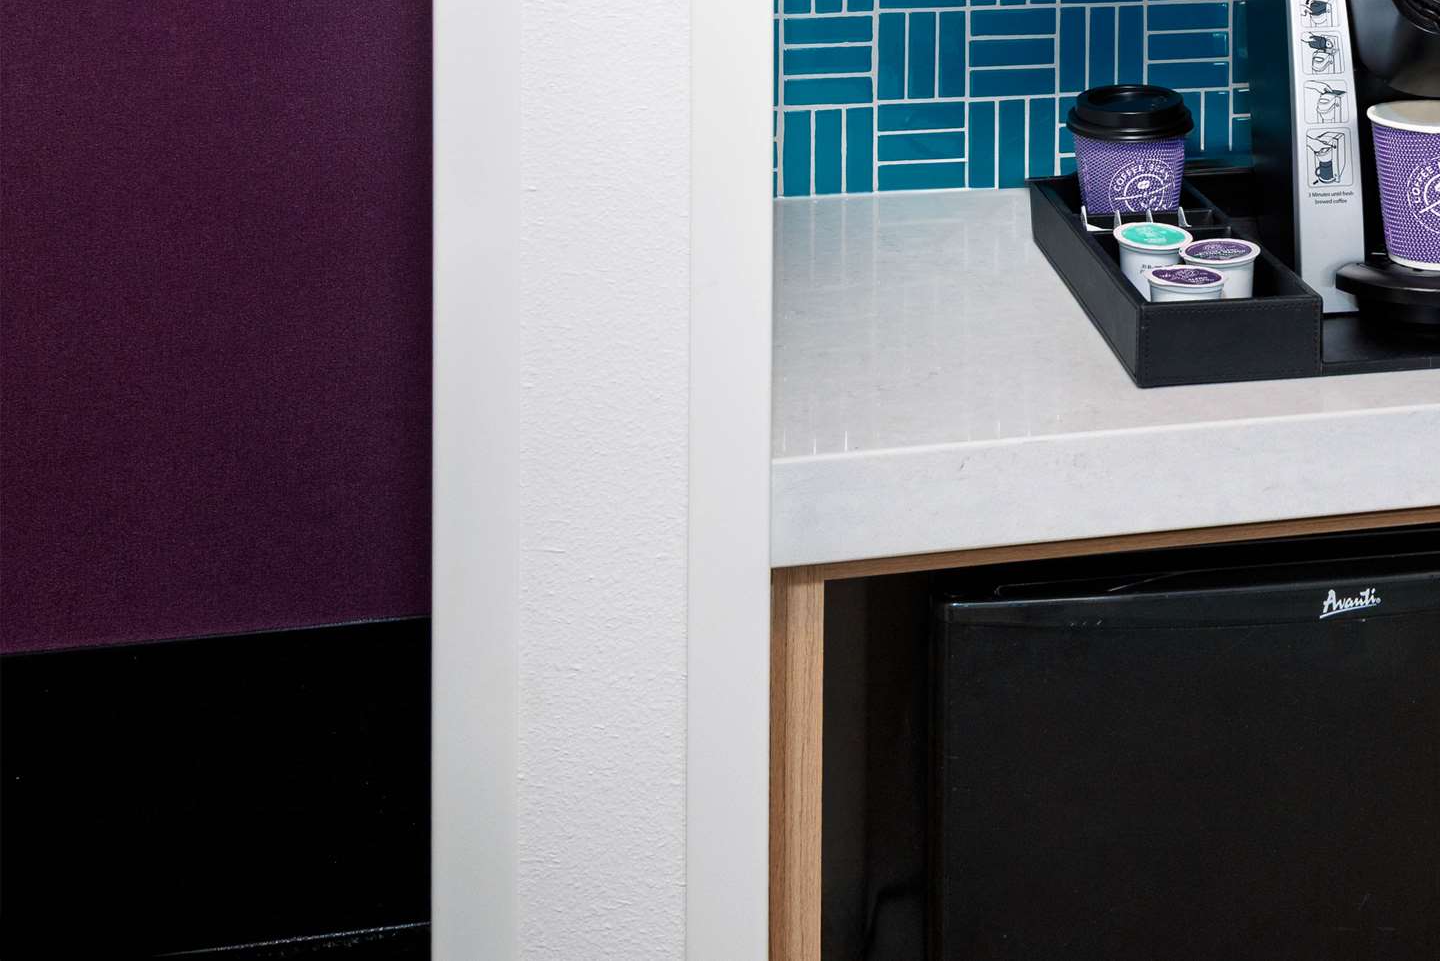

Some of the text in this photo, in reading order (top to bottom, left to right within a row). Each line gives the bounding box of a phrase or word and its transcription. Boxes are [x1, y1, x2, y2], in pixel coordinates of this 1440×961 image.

[1113, 164, 1169, 192] COFFEE BEAN
[1412, 166, 1434, 203] COFFEE
[1322, 588, 1376, 613] Avanti
